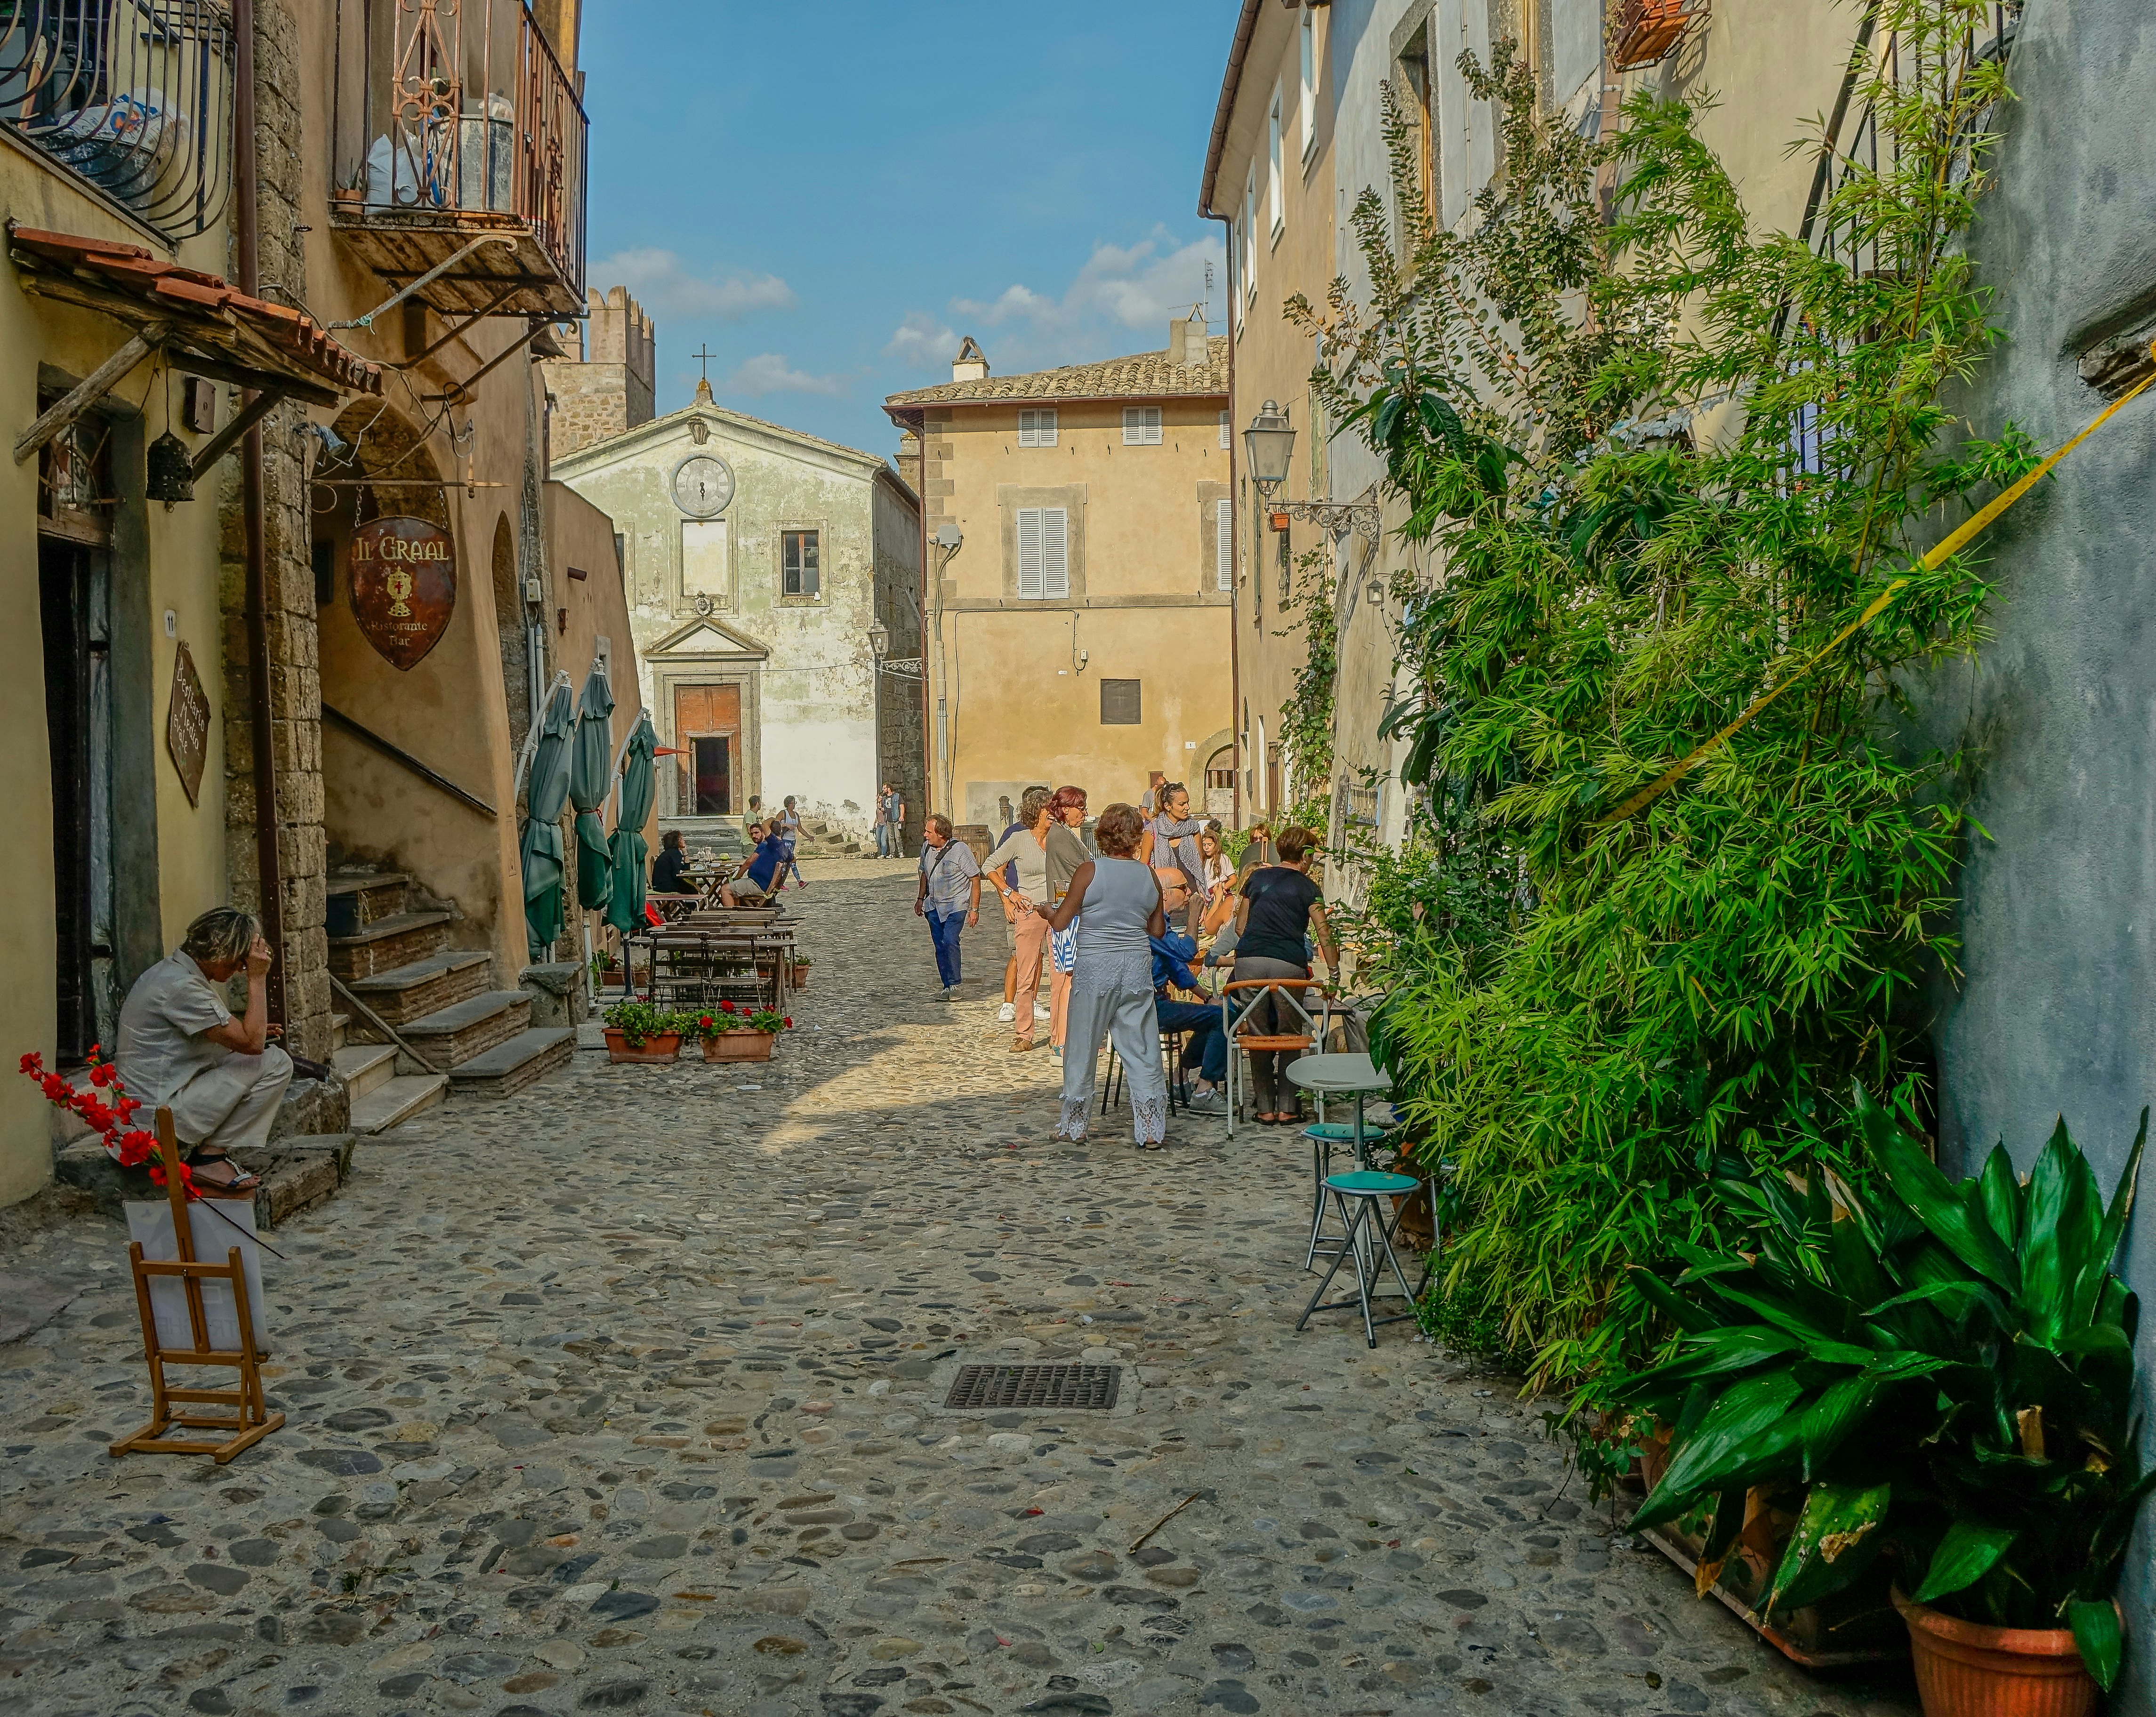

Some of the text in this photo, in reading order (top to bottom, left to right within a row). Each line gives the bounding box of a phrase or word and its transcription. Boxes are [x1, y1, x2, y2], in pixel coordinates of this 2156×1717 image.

[379, 536, 449, 563] GRAAL
[168, 615, 173, 631] 11
[371, 621, 427, 631] Ristorante
[389, 635, 410, 646] Bar
[177, 656, 205, 731] Bestiario
[174, 714, 188, 753] evale
